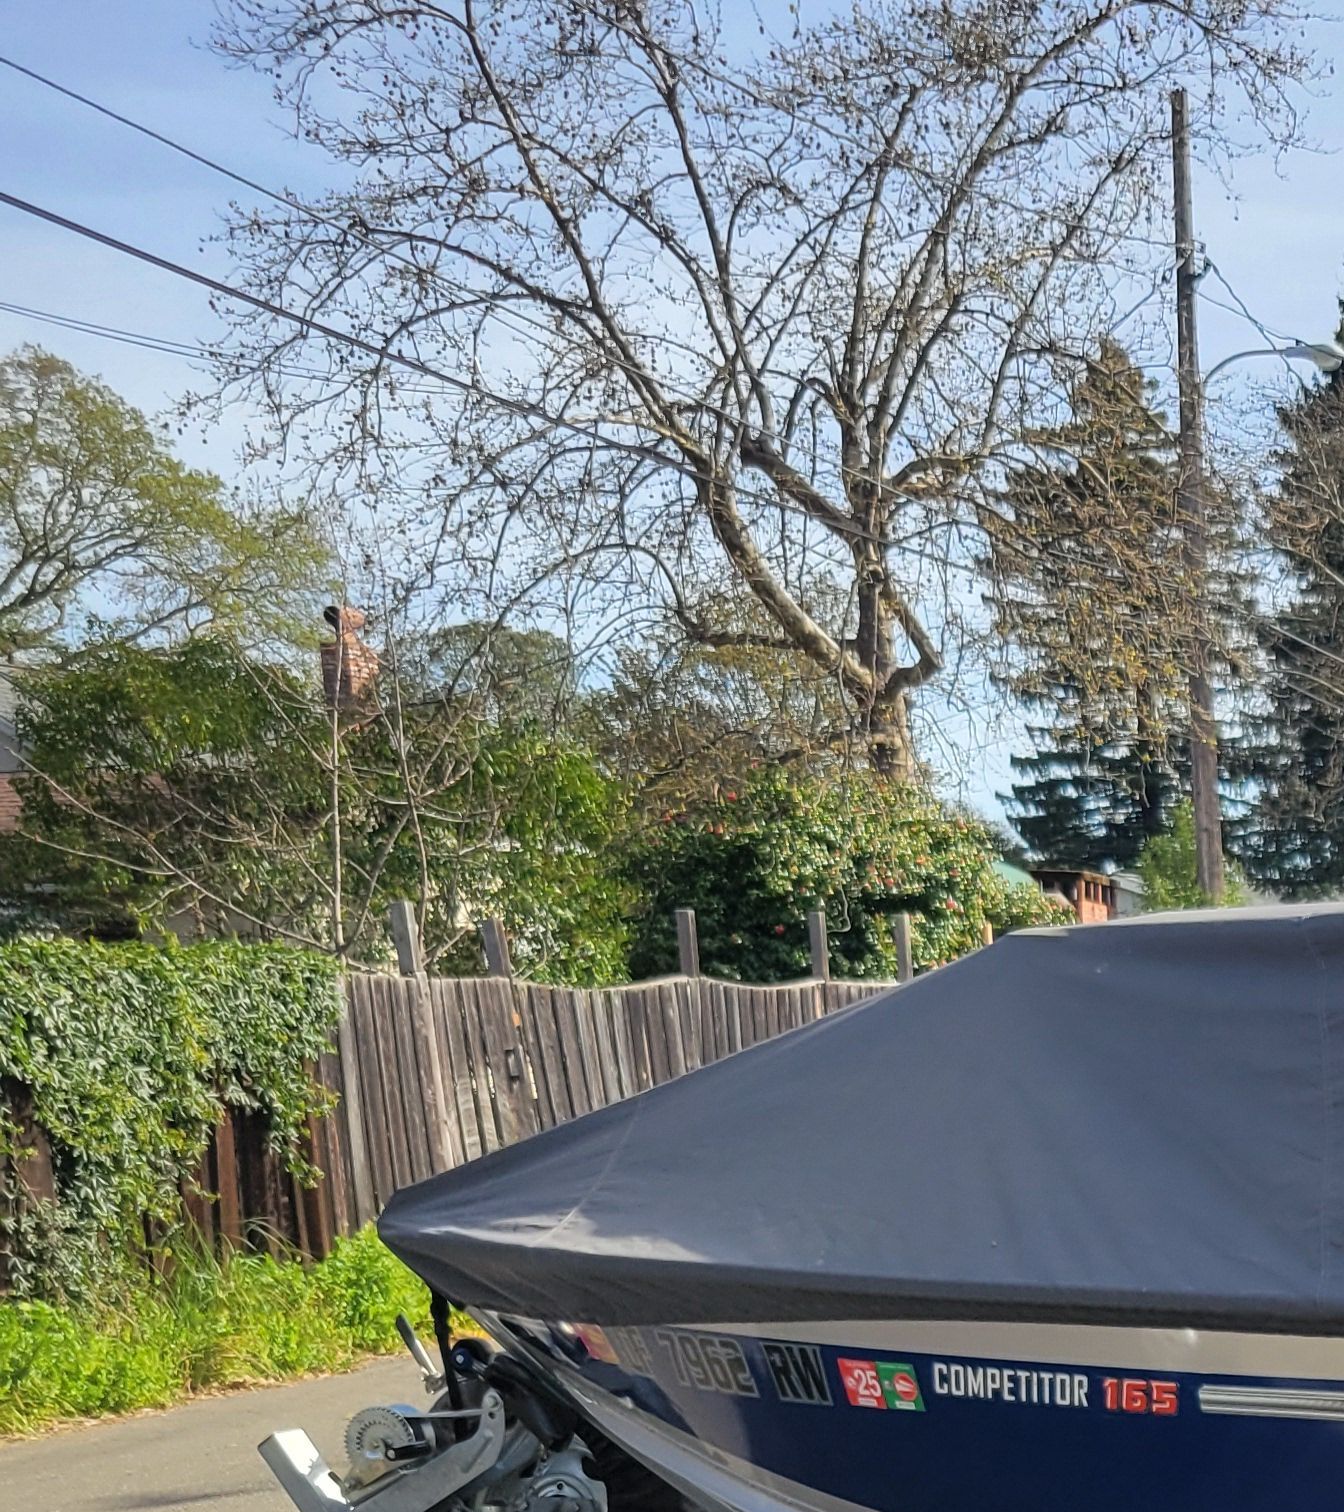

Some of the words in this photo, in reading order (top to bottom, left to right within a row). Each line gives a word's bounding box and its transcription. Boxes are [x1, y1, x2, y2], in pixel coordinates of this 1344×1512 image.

[655, 1328, 761, 1398] 7962
[759, 1341, 834, 1406] RW
[853, 1368, 882, 1397] 25
[932, 1362, 1090, 1408] COMPETITOR
[1102, 1376, 1180, 1417] 165
